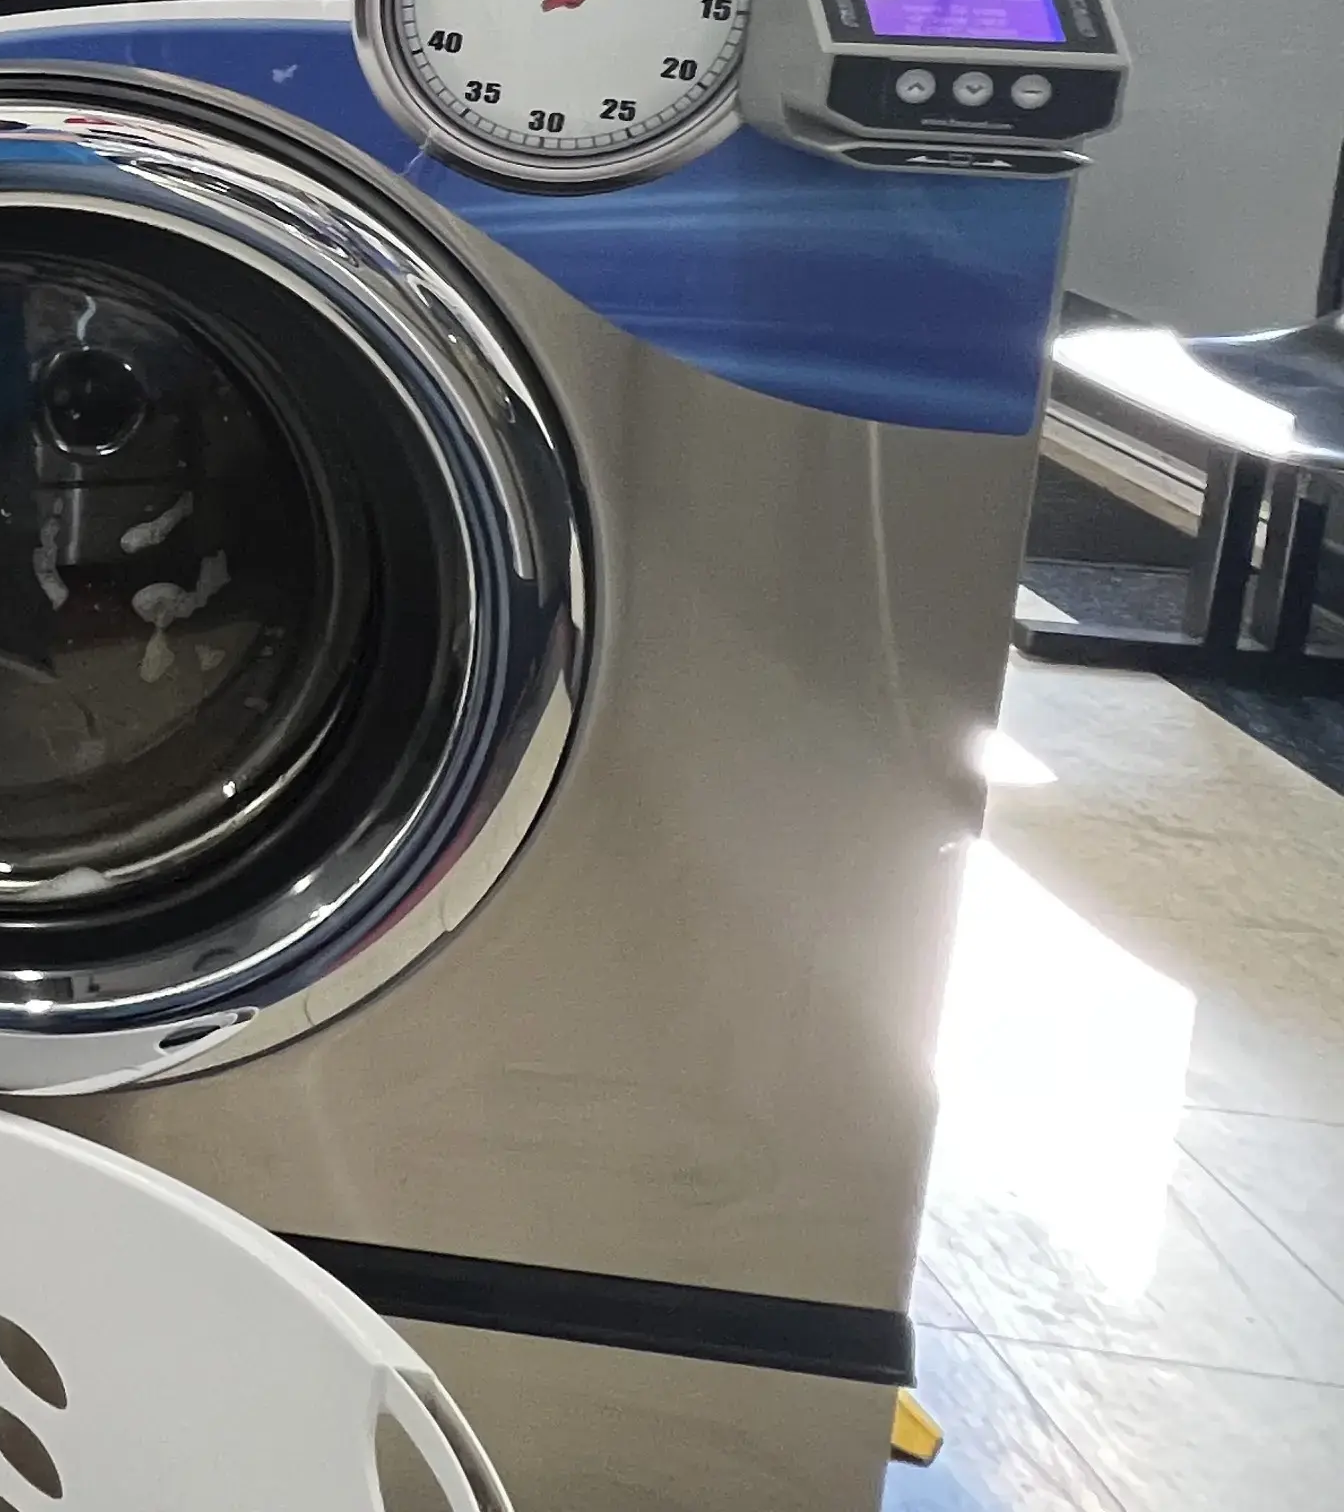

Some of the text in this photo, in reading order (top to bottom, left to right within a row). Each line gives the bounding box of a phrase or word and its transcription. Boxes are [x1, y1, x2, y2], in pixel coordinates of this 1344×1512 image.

[427, 30, 463, 53] 40
[661, 57, 698, 81] 20
[464, 81, 501, 105] 35
[528, 109, 566, 134] 30
[600, 99, 637, 123] 25
